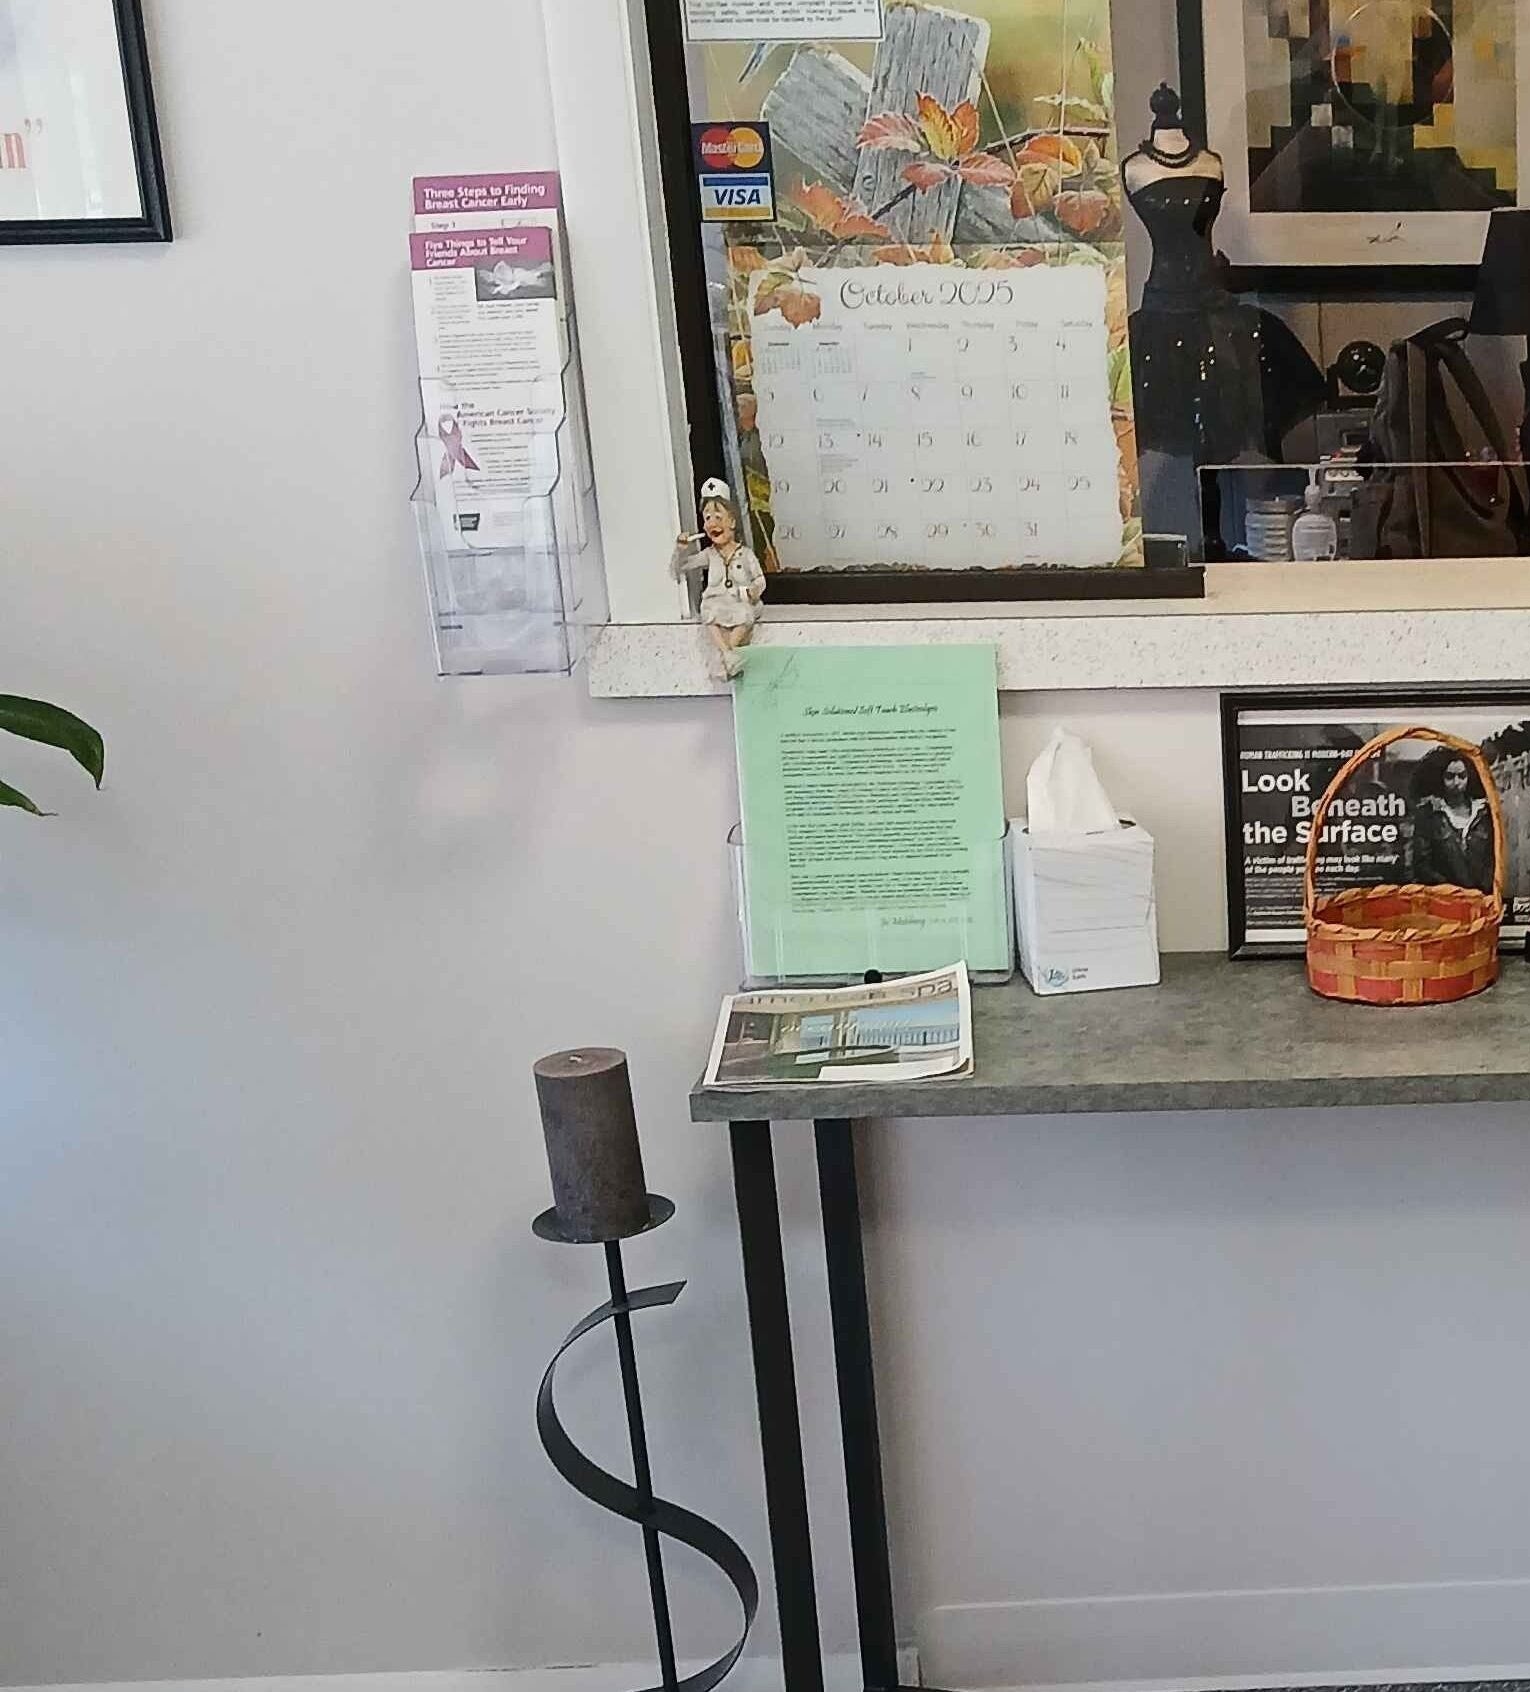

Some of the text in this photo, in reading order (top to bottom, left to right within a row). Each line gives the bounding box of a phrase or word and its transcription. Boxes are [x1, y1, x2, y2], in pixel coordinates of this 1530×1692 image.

[423, 183, 546, 199] Three Steps to Finding
[714, 188, 761, 206] VISA
[424, 195, 528, 210] Breast Cancer Early
[424, 236, 528, 250] Five Things to Tell Your
[425, 245, 518, 259] Friends About Breast
[425, 257, 456, 267] Cancer
[840, 279, 1014, 310] October 2025
[956, 337, 970, 353] 2
[1008, 335, 1018, 353] 3
[961, 384, 973, 399] 9
[1011, 383, 1027, 400] 10
[1060, 384, 1070, 399] 11
[456, 409, 495, 419] American
[497, 408, 525, 417] Cancer
[489, 418, 515, 427] Breast
[768, 433, 784, 449] 12
[818, 432, 834, 449] 13
[867, 432, 883, 448] 14
[917, 431, 933, 448] 15
[966, 431, 983, 448] 16
[774, 474, 1092, 495] 19 20 21 22 23 24 25
[926, 523, 949, 538] 29
[974, 521, 997, 538] 30
[1024, 521, 1039, 537] 31
[1241, 768, 1312, 794] Look
[1291, 792, 1407, 818] Beneath
[1242, 819, 1399, 845] the Surface
[1252, 855, 1277, 865] victim
[1277, 855, 1286, 865] of
[1325, 856, 1343, 866] may
[1343, 854, 1361, 864] look
[1361, 854, 1375, 864] like
[1375, 854, 1398, 865] many
[1244, 864, 1254, 874] of
[1254, 864, 1267, 874] the
[1268, 865, 1294, 875] people
[1325, 864, 1344, 873] each
